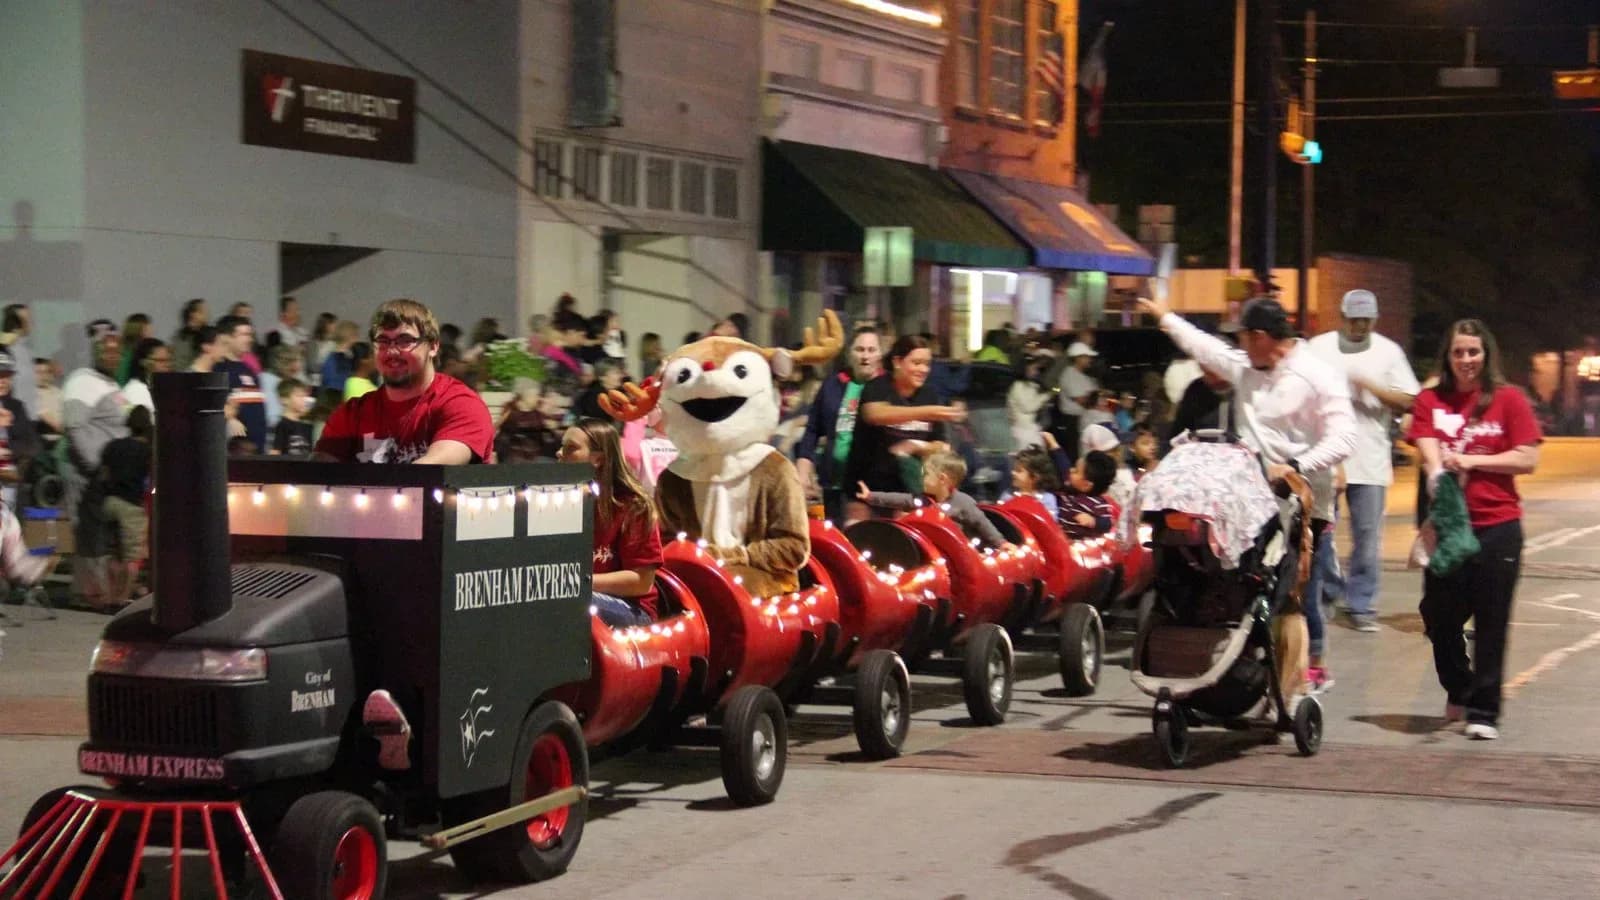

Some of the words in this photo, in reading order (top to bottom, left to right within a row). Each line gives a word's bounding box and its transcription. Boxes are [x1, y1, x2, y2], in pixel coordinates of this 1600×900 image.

[301, 84, 402, 120] THRIVENT
[303, 117, 379, 141] FINANCIAL
[455, 567, 523, 611] BRENHAM
[525, 562, 581, 602] EXPRESS
[305, 671, 321, 687] City
[322, 668, 332, 682] of
[79, 750, 149, 776] BRENHAM
[151, 755, 225, 780] EXPRESS
